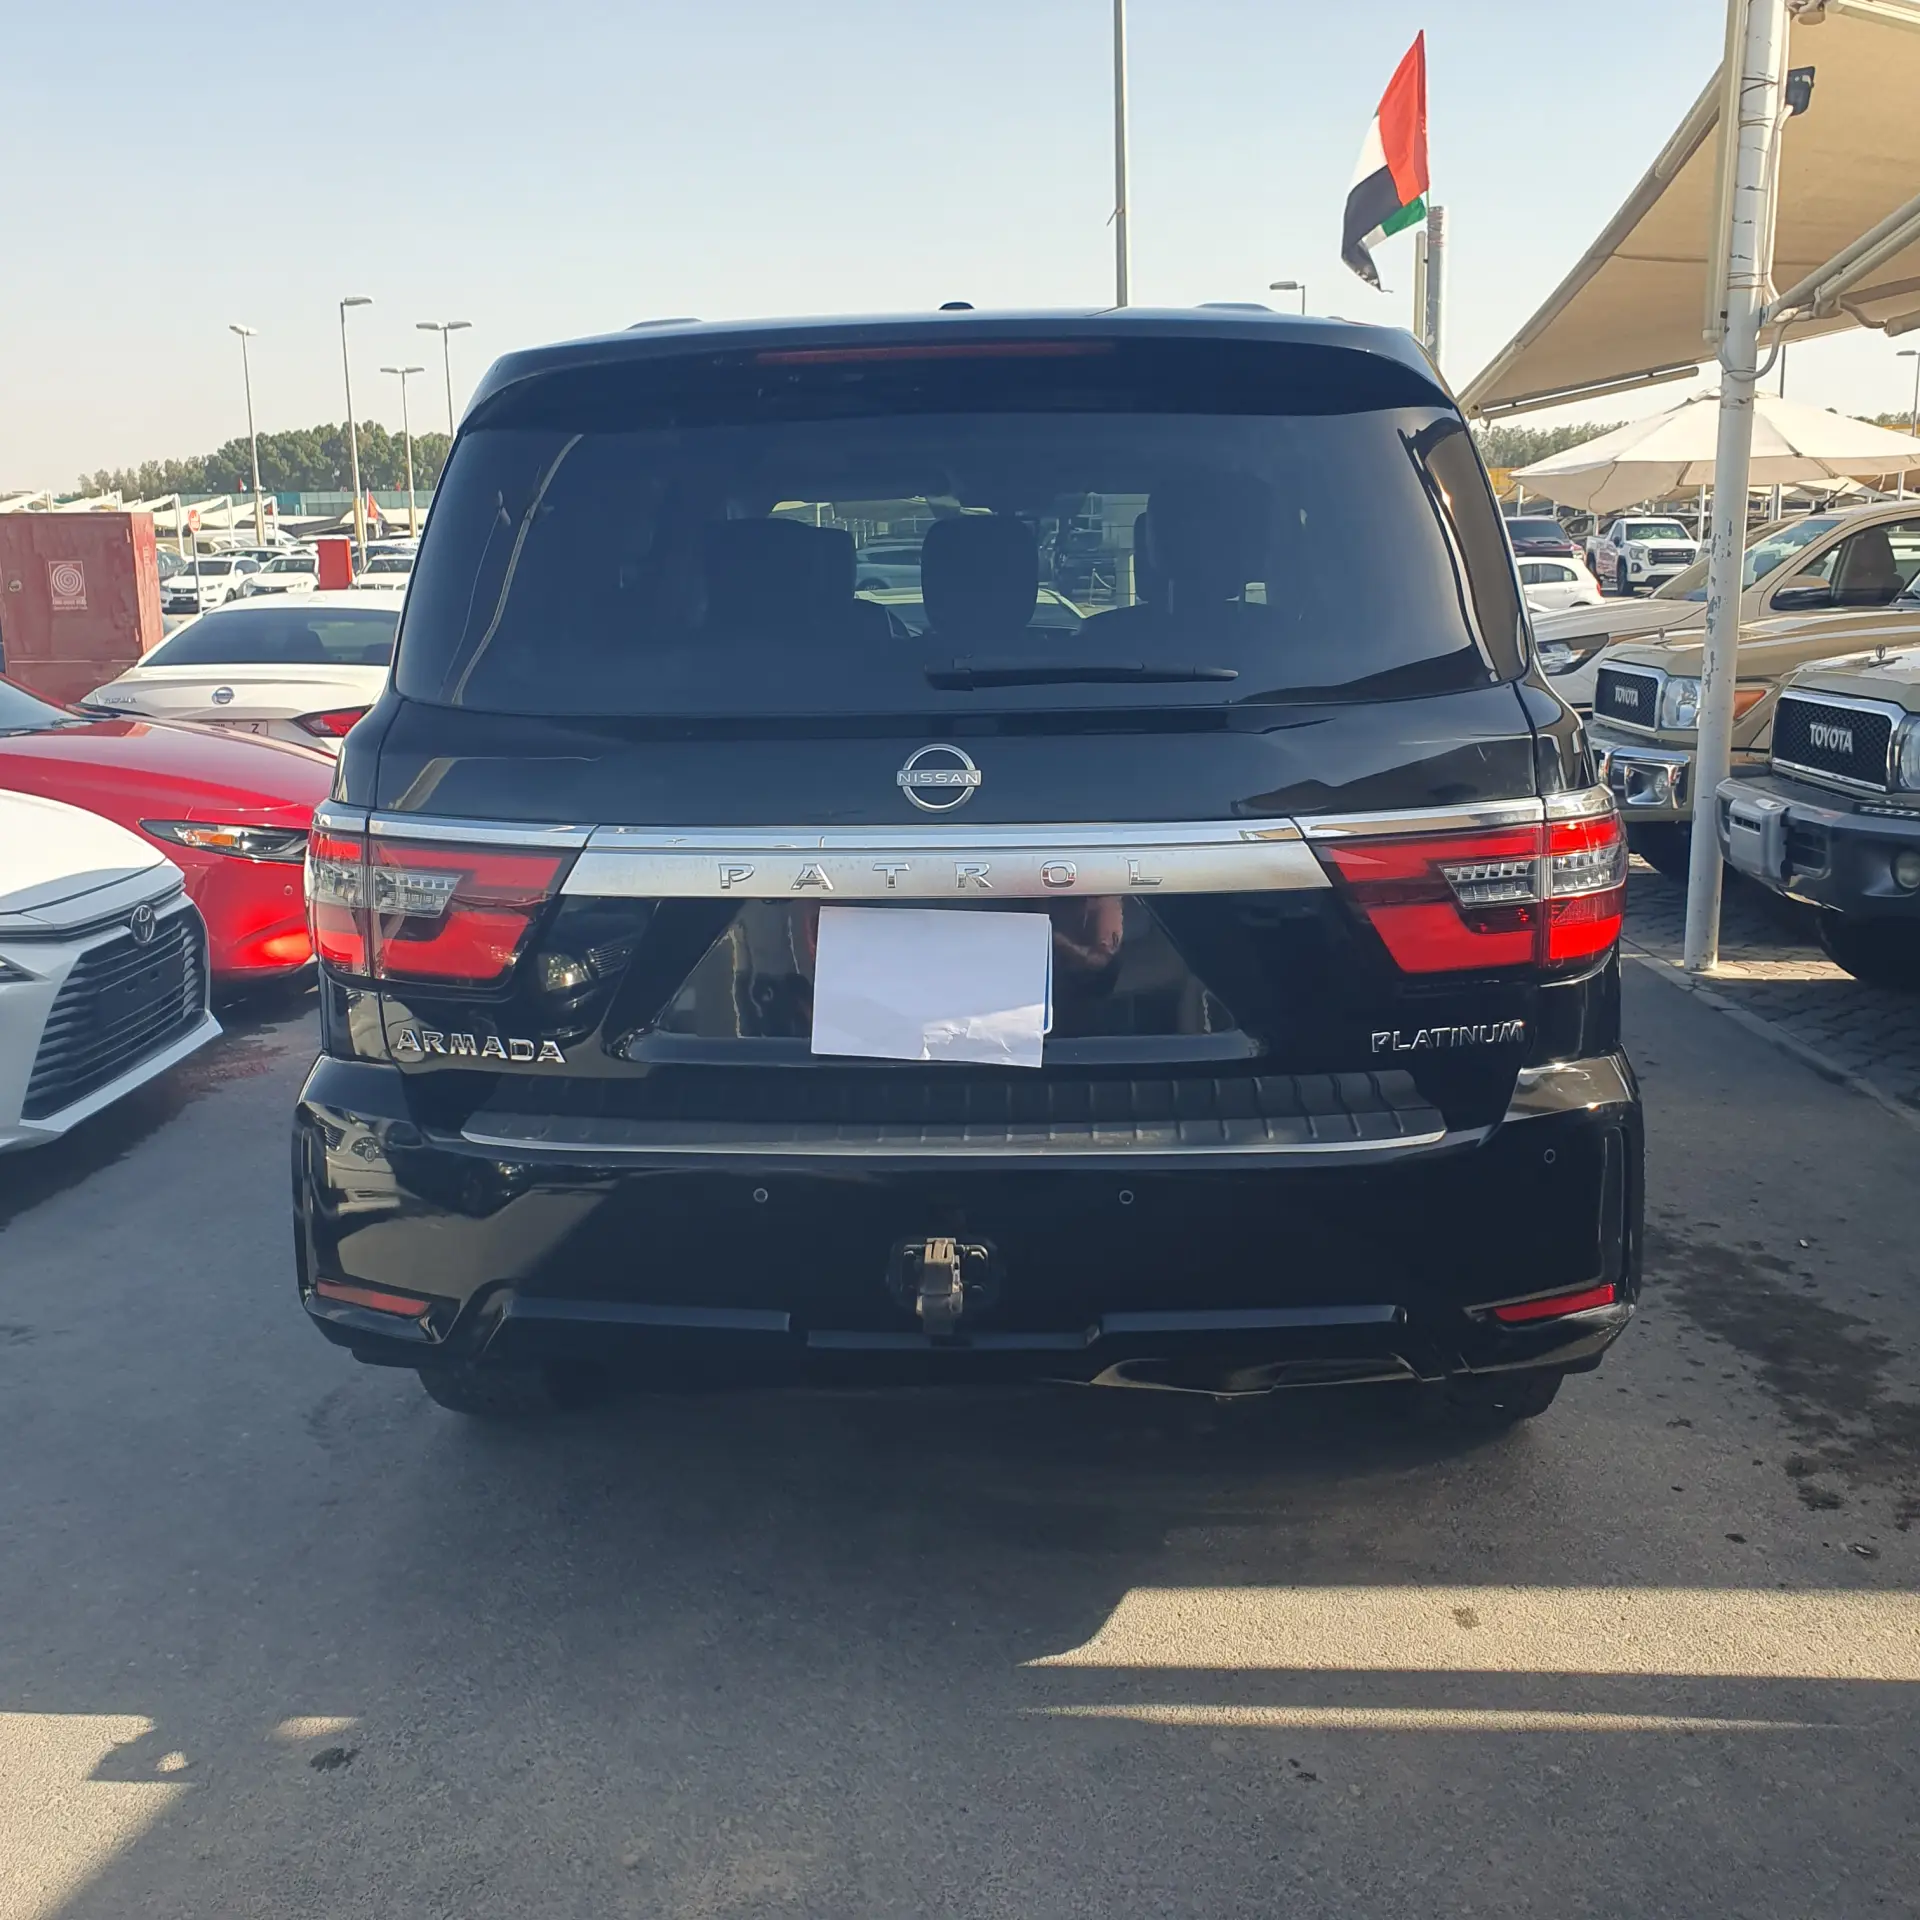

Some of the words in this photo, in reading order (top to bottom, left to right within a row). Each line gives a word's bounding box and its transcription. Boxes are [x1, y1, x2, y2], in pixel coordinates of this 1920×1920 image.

[1810, 723, 1853, 753] TOYOTA
[899, 773, 978, 784] NISSAN
[718, 859, 1164, 891] PATROL
[397, 1028, 566, 1063] ARMADA
[1371, 1019, 1524, 1052] PLATINUM
